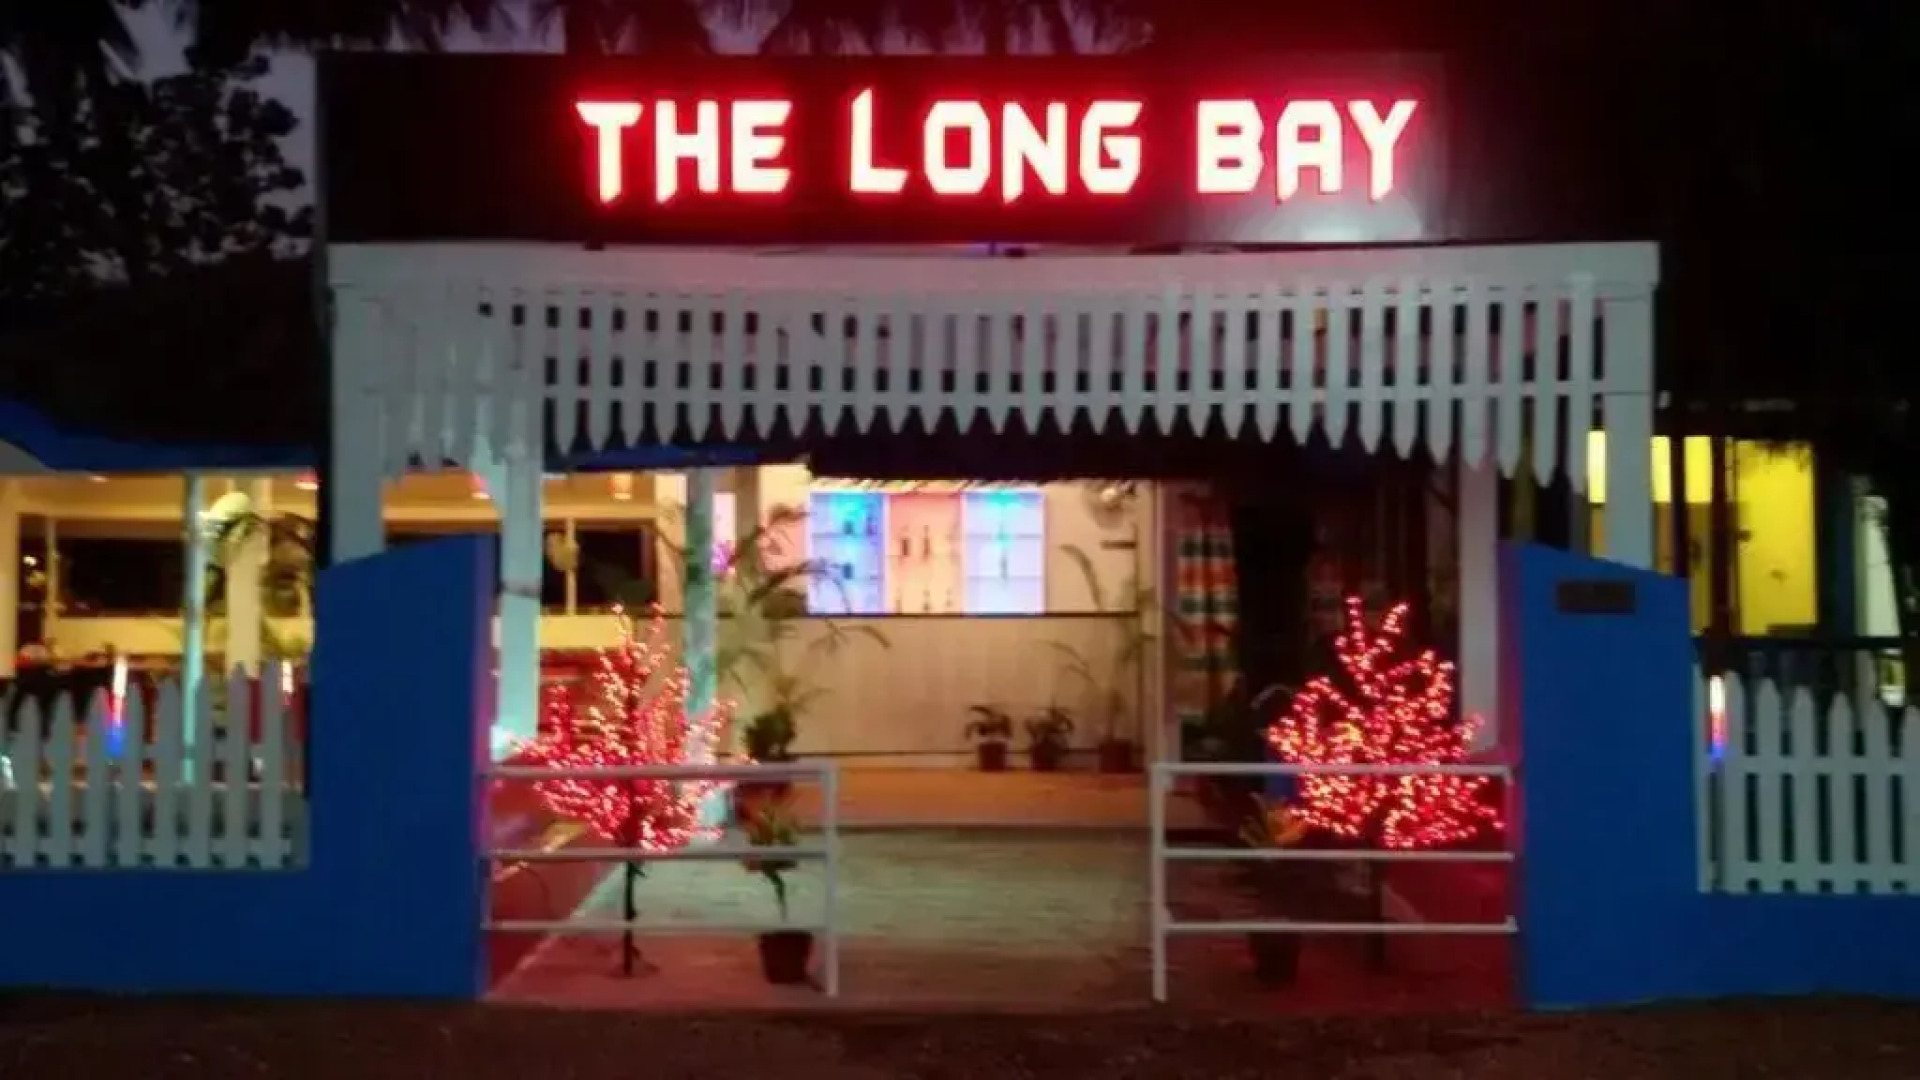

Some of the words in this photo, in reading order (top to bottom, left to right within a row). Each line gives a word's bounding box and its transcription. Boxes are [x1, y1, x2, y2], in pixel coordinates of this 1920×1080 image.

[576, 100, 792, 204] THE
[848, 88, 1143, 204] LONG
[1196, 100, 1420, 204] BAY
